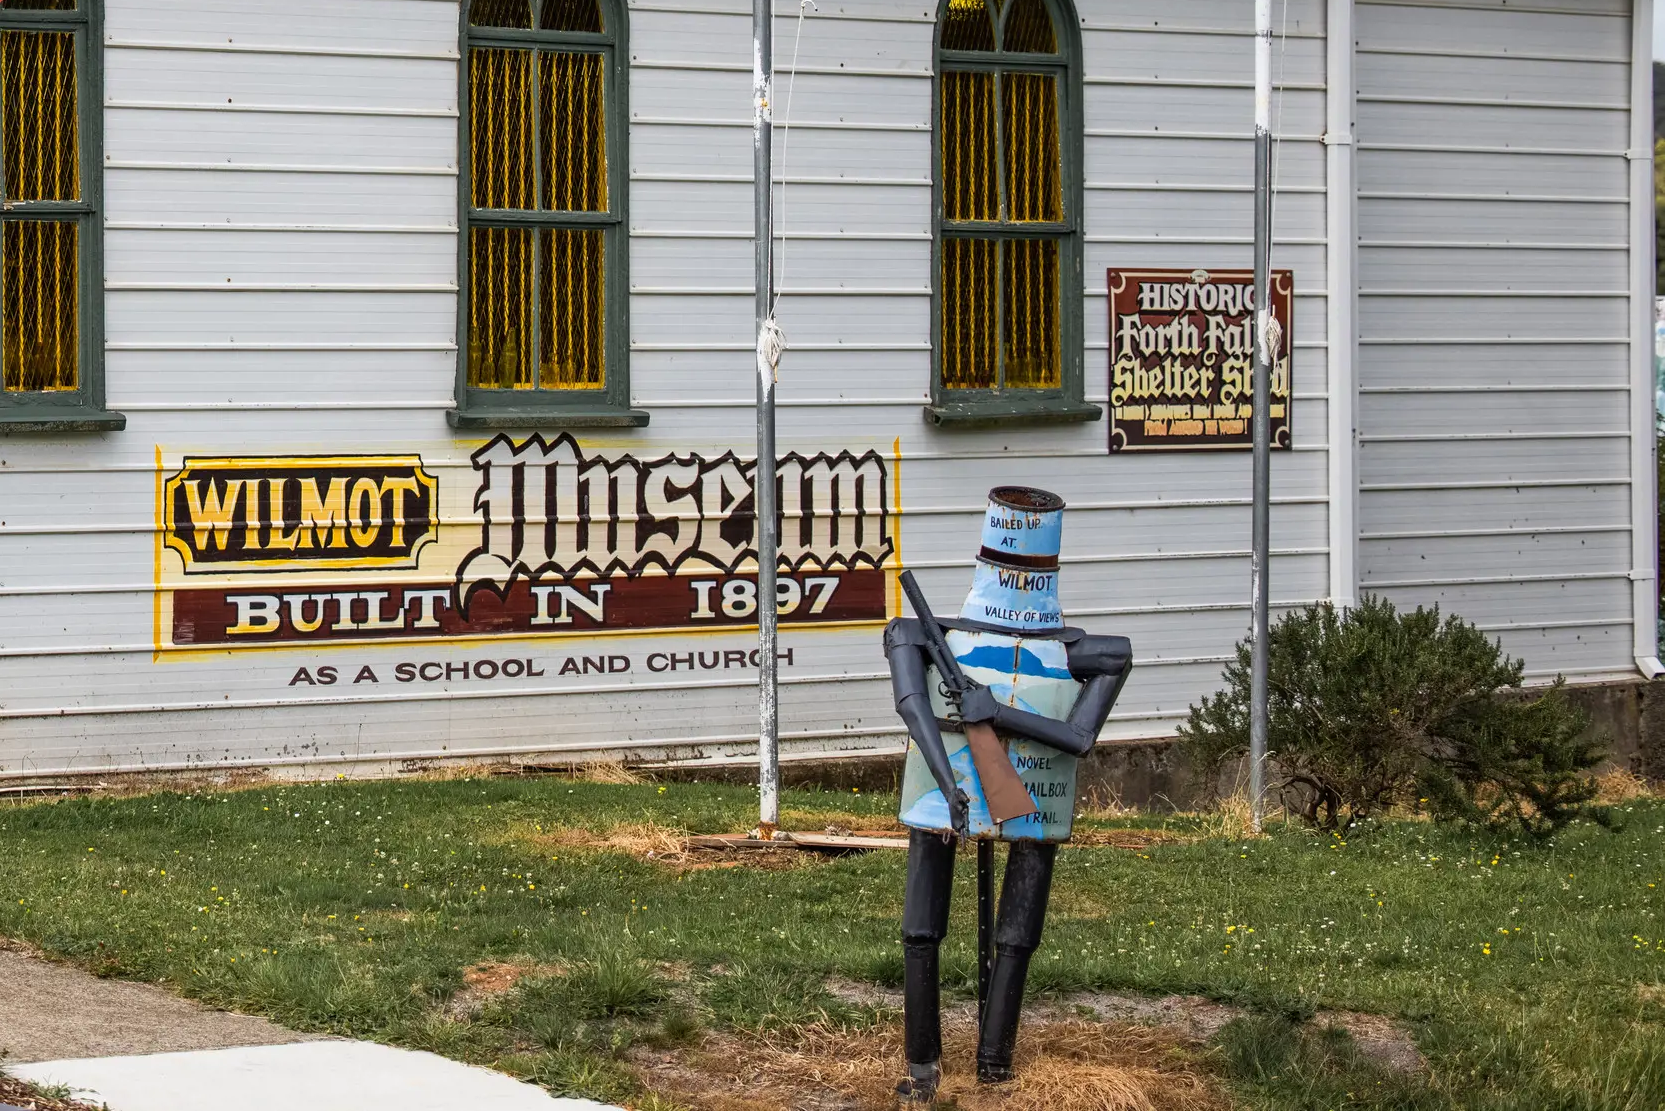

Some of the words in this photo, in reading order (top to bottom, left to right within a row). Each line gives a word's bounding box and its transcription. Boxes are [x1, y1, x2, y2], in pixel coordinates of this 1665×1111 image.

[1138, 282, 1255, 316] HISTORIC
[1116, 314, 1203, 362] Forth
[1111, 357, 1216, 405] Shelter
[182, 475, 420, 551] WILMOT
[457, 431, 895, 612] Museum
[990, 516, 1023, 530] BAILED
[225, 589, 451, 635] BUILT
[530, 583, 612, 625] IN
[690, 576, 841, 619] 1897
[985, 605, 1022, 622] VALLEY
[1023, 611, 1037, 623] OF
[1038, 612, 1060, 623] VIEWS
[288, 665, 339, 687] AS
[353, 664, 380, 684] A
[394, 658, 546, 683] SCHOOL
[557, 655, 631, 676] AND
[1016, 756, 1052, 770] NOVEL
